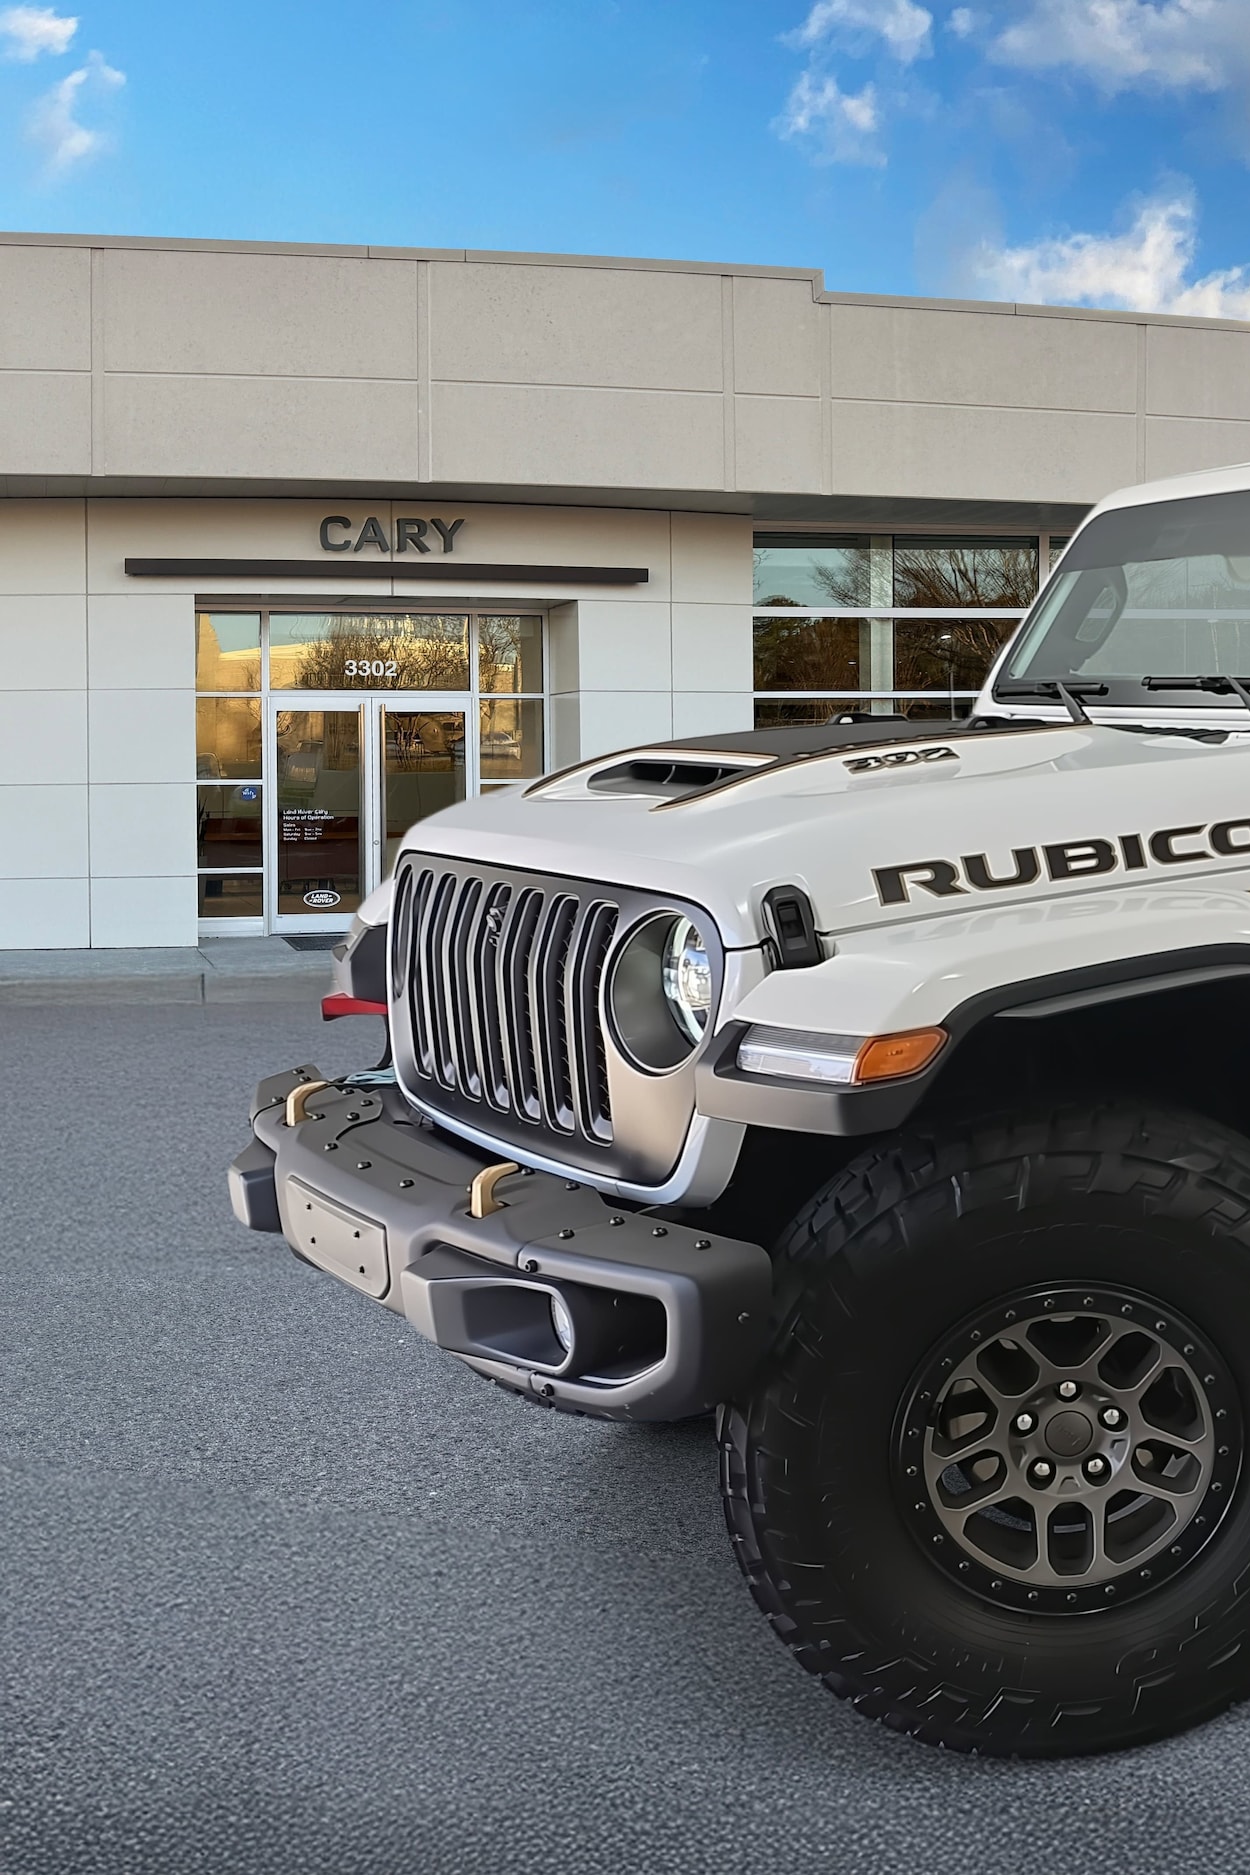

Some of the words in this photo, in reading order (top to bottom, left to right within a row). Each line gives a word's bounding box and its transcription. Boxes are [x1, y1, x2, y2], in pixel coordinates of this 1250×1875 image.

[319, 515, 465, 554] CARY
[344, 659, 398, 677] 3302
[842, 747, 960, 775] 392
